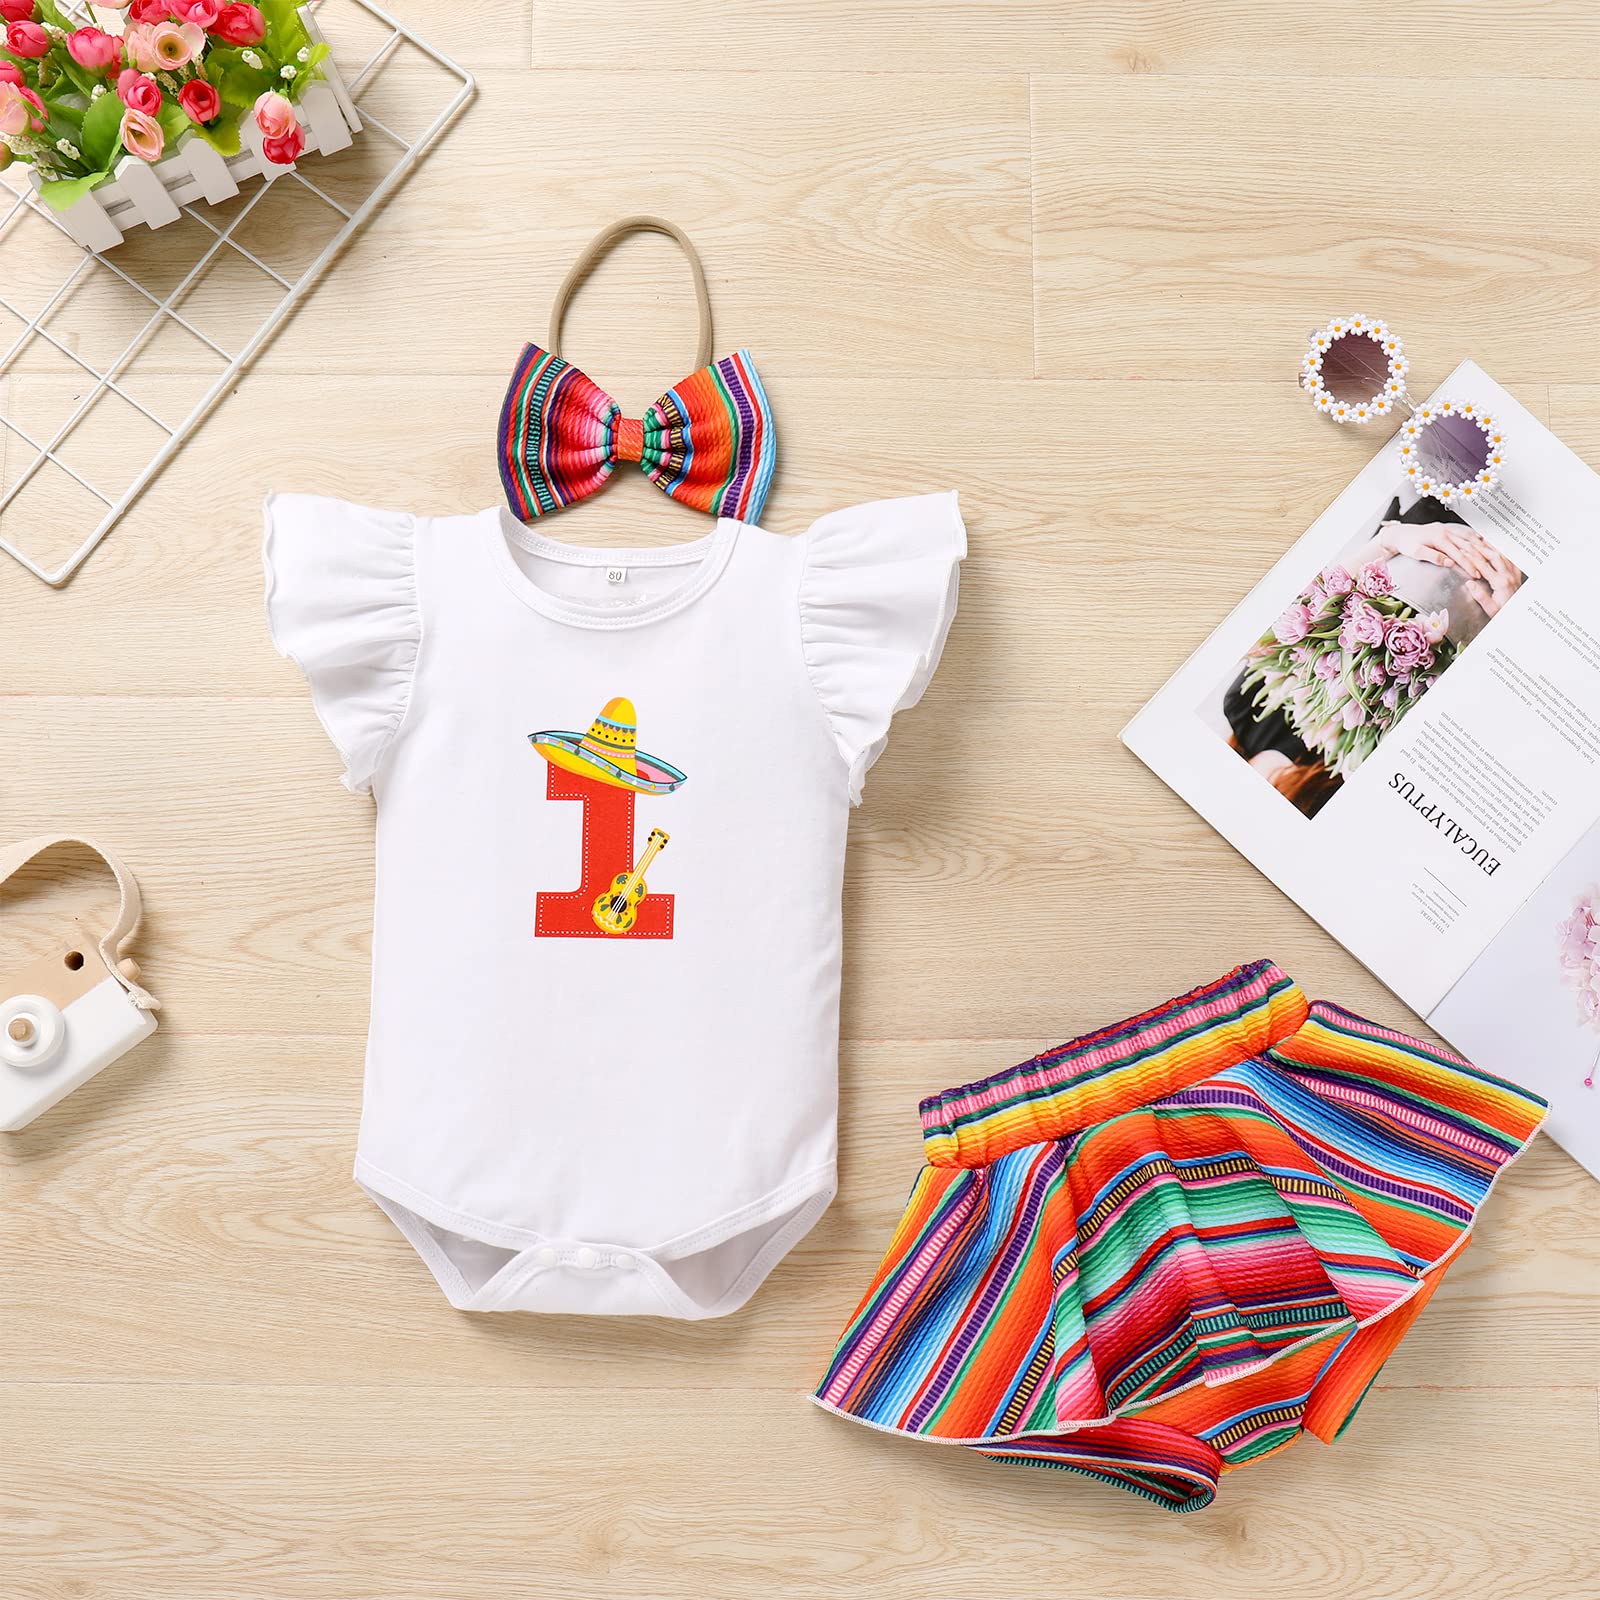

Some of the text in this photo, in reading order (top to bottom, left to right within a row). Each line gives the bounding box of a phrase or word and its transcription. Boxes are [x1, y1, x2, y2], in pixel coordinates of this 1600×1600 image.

[608, 570, 622, 581] 80
[534, 759, 675, 939] 1
[1388, 772, 1502, 876] EUCALYPTUS
